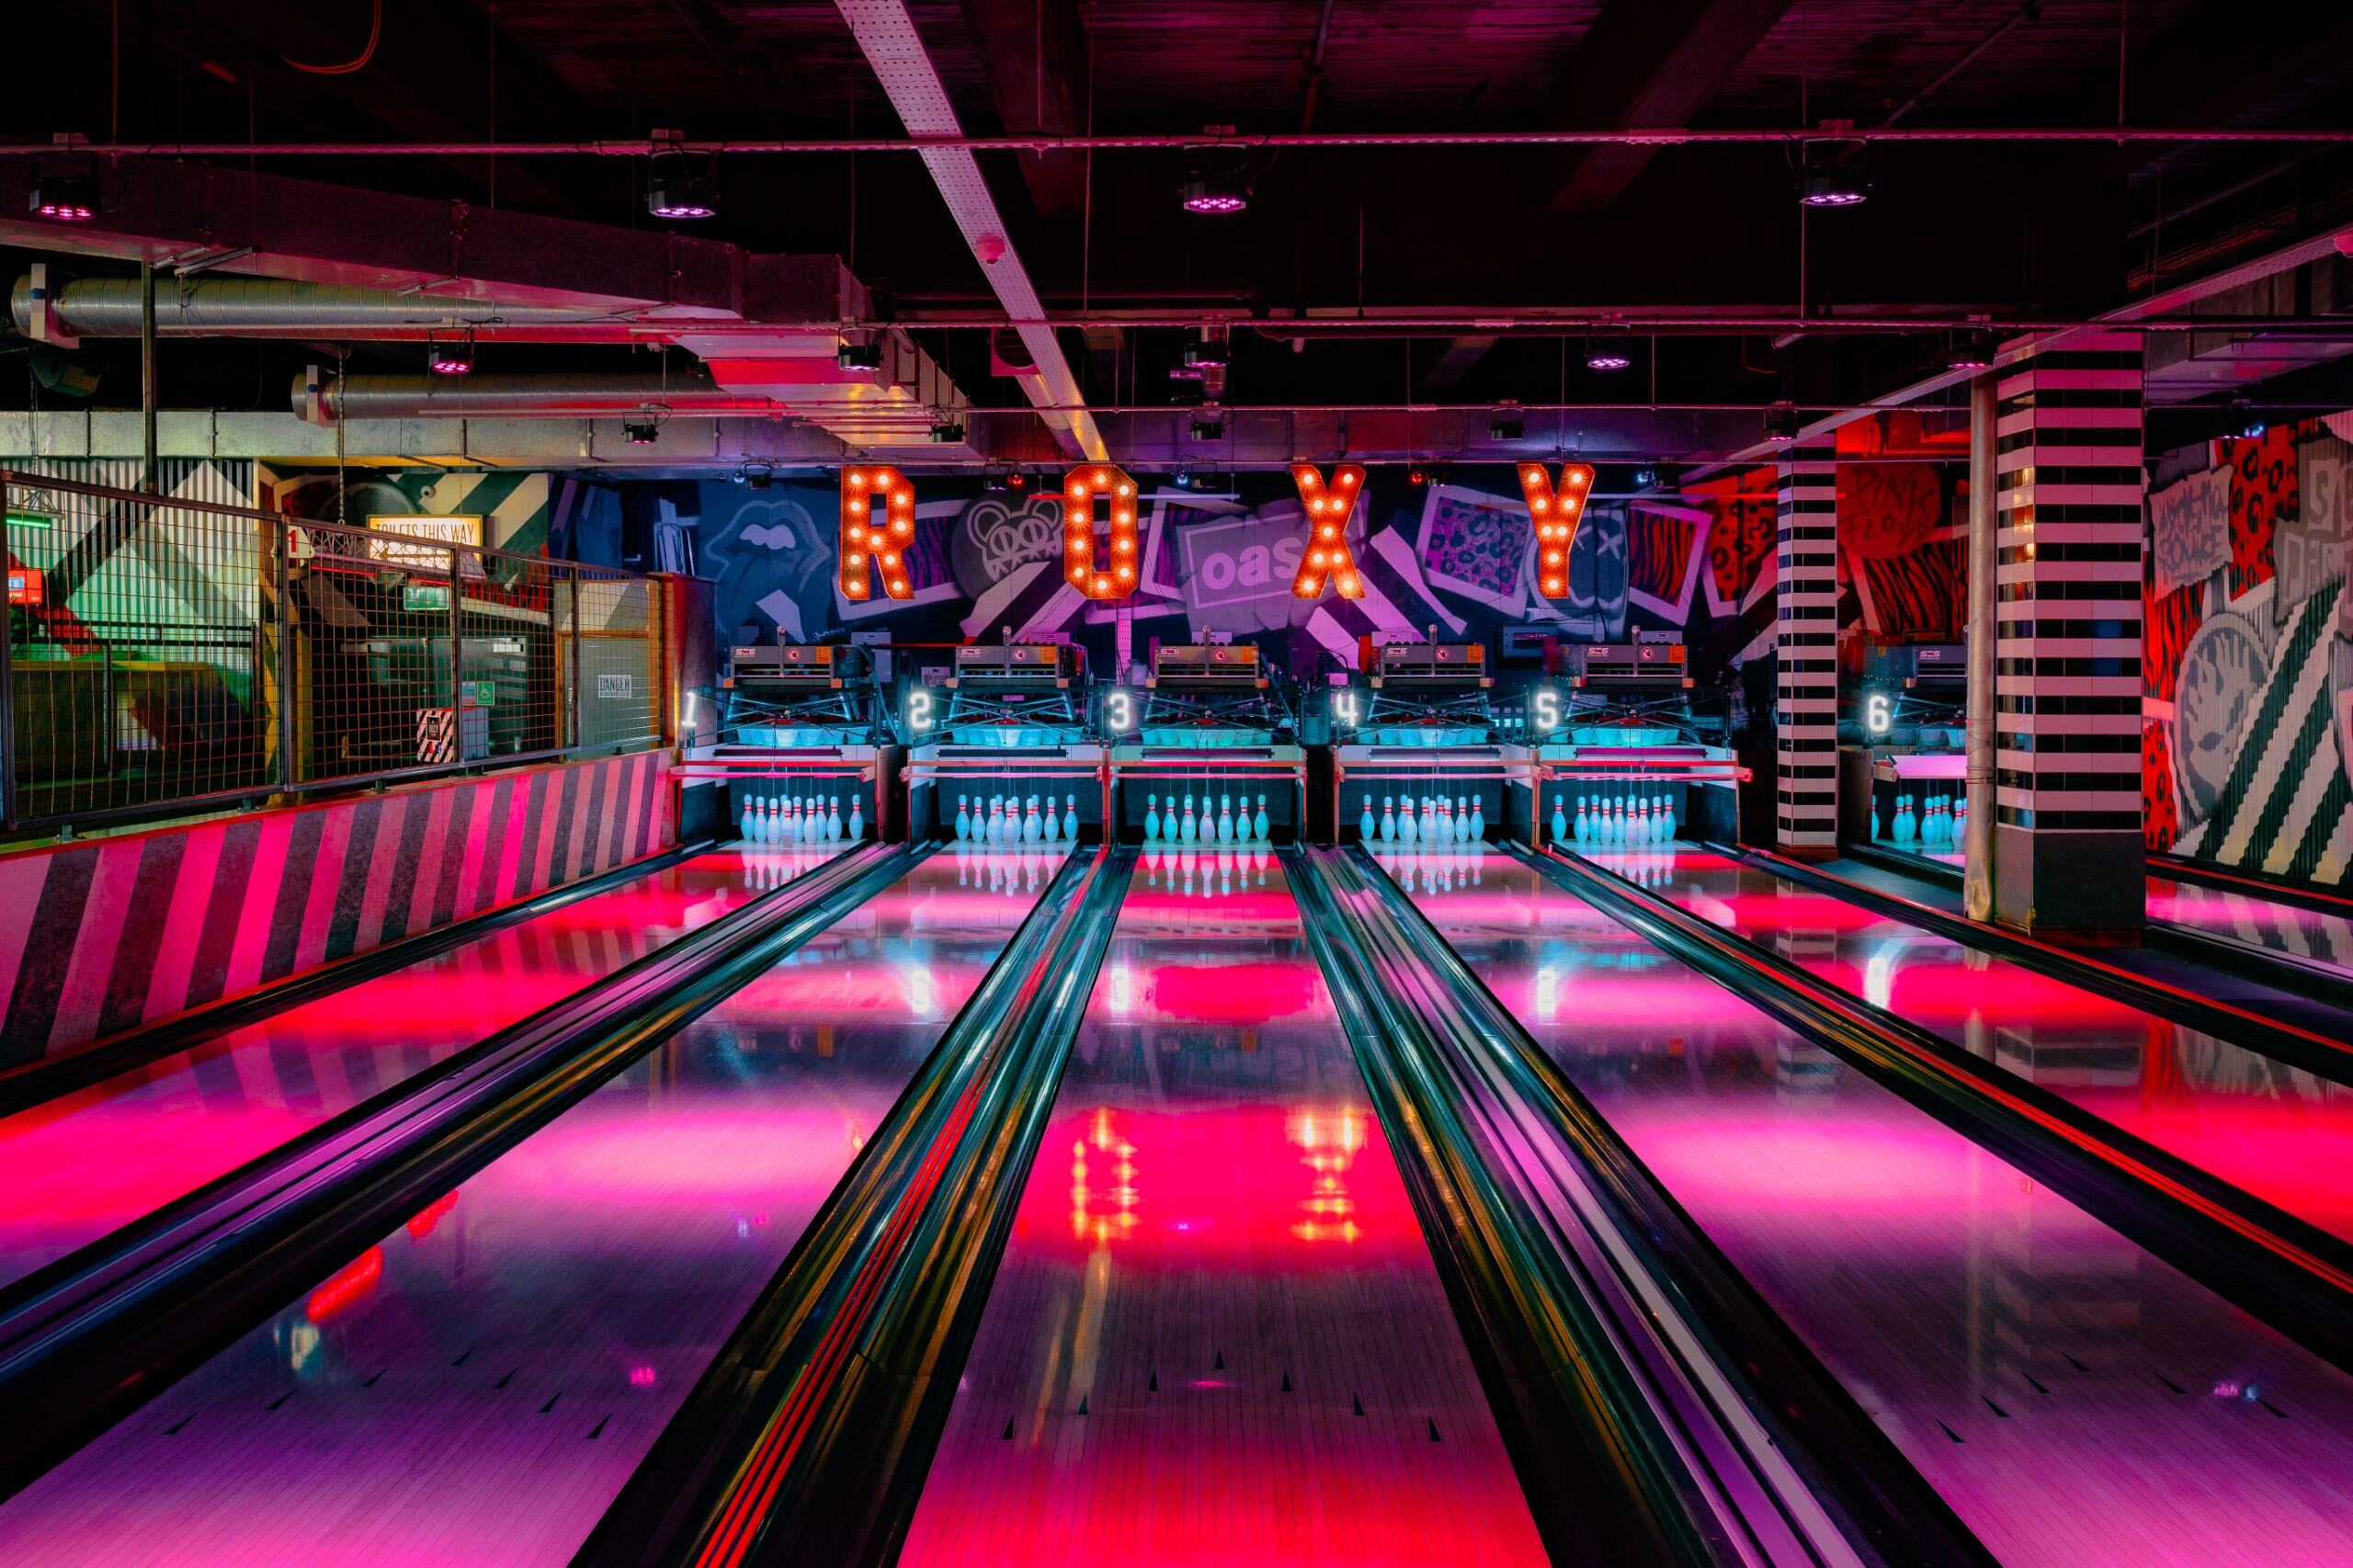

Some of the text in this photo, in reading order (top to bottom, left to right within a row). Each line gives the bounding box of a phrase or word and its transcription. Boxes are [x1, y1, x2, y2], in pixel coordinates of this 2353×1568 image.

[1851, 465, 1936, 528] PINK
[422, 524, 447, 540] THIS
[450, 524, 474, 543] WAY
[840, 463, 1595, 600] ROXY
[1838, 510, 1930, 550] FLOYD
[681, 691, 698, 729] 1
[910, 692, 931, 729] 2
[1109, 692, 1131, 730] 3
[1336, 692, 1358, 728] 4
[1868, 695, 1889, 732] 6
